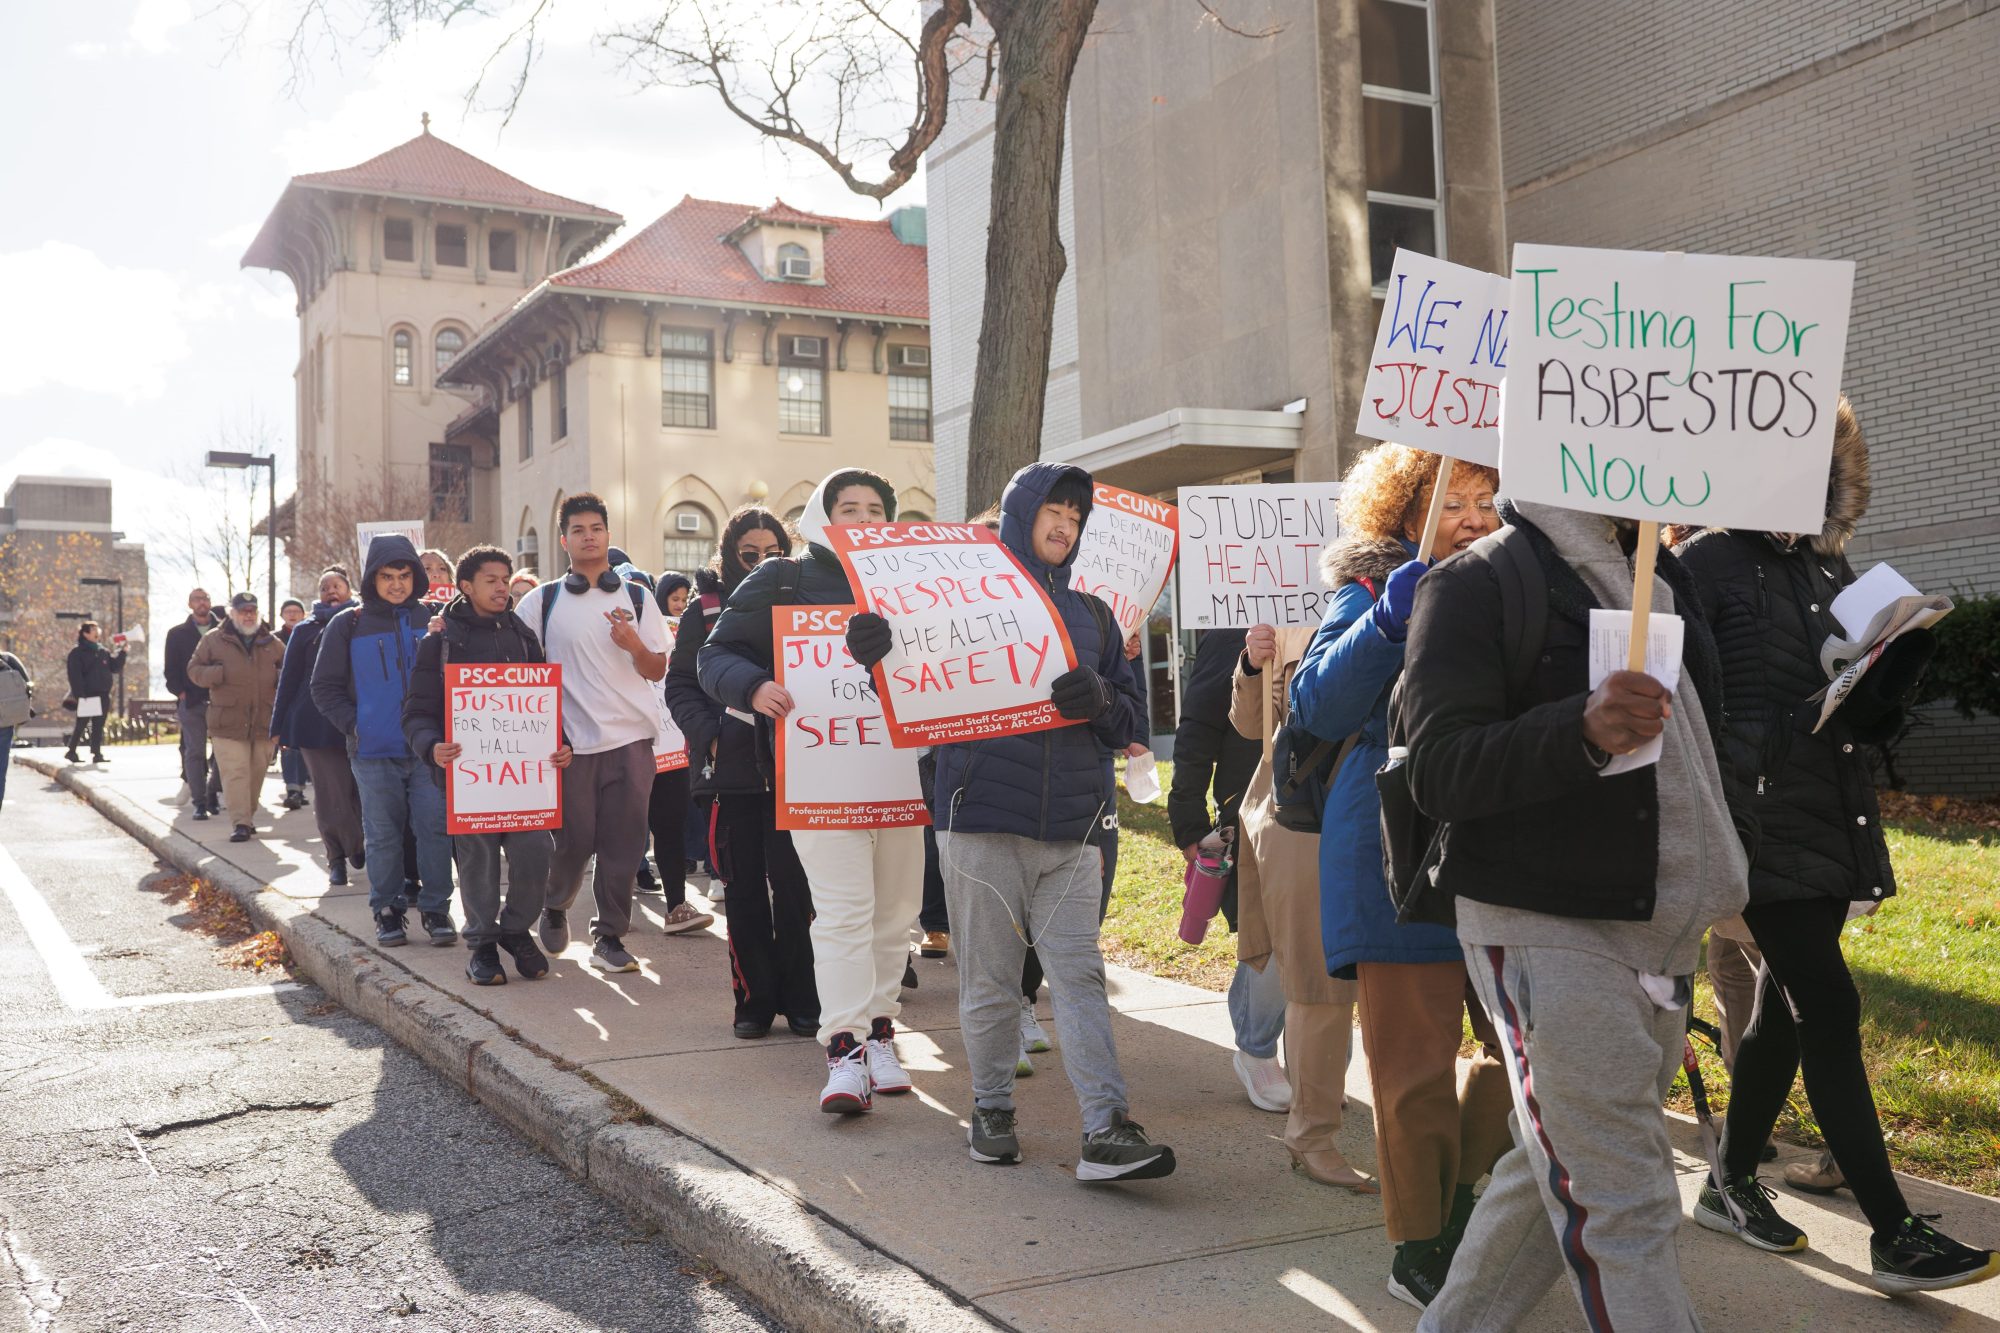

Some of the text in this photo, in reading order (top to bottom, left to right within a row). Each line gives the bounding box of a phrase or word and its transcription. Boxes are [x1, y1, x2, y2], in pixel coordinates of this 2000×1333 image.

[1386, 274, 1463, 354] WE
[1515, 268, 1820, 387] Testing For
[1537, 358, 1818, 438] ASBESTOS
[1093, 487, 1170, 522] C-CUNY
[845, 525, 979, 547] PSC-CUNY
[1086, 525, 1147, 564] HEALTH
[1109, 512, 1171, 553] DEMAND
[857, 551, 997, 576] JUSTICE
[1078, 549, 1150, 593] SAFETY
[1205, 543, 1326, 588] HEALT
[868, 573, 1025, 619] RESPECT
[899, 609, 1024, 657] HEALTH
[459, 667, 553, 685] PSC-CUNY
[892, 634, 1050, 695] SAFETY
[453, 690, 551, 714] JUSTICE
[831, 678, 876, 703] FOR
[453, 717, 550, 735] FOR DELANY
[796, 714, 884, 749] SEE
[903, 702, 1057, 734] Professional Staff Congress/CU
[927, 731, 946, 741] AFT
[948, 727, 974, 738] Local
[976, 724, 1003, 736] 2334
[1010, 714, 1052, 730] AFL-CIO
[480, 738, 527, 755] HALL
[458, 759, 553, 786] STAFF
[456, 815, 496, 823] Professional
[512, 811, 555, 821] Congress/CUNY
[789, 802, 927, 815] Professional Staff Congress/CUN
[808, 816, 825, 824] AFT
[827, 815, 849, 824] Local
[851, 815, 874, 824] 2334
[880, 813, 915, 823] AFL-CIO
[471, 822, 483, 830] AFT
[484, 821, 501, 829] Local
[502, 820, 518, 828] 2334
[522, 819, 545, 827] AFL-CIO
